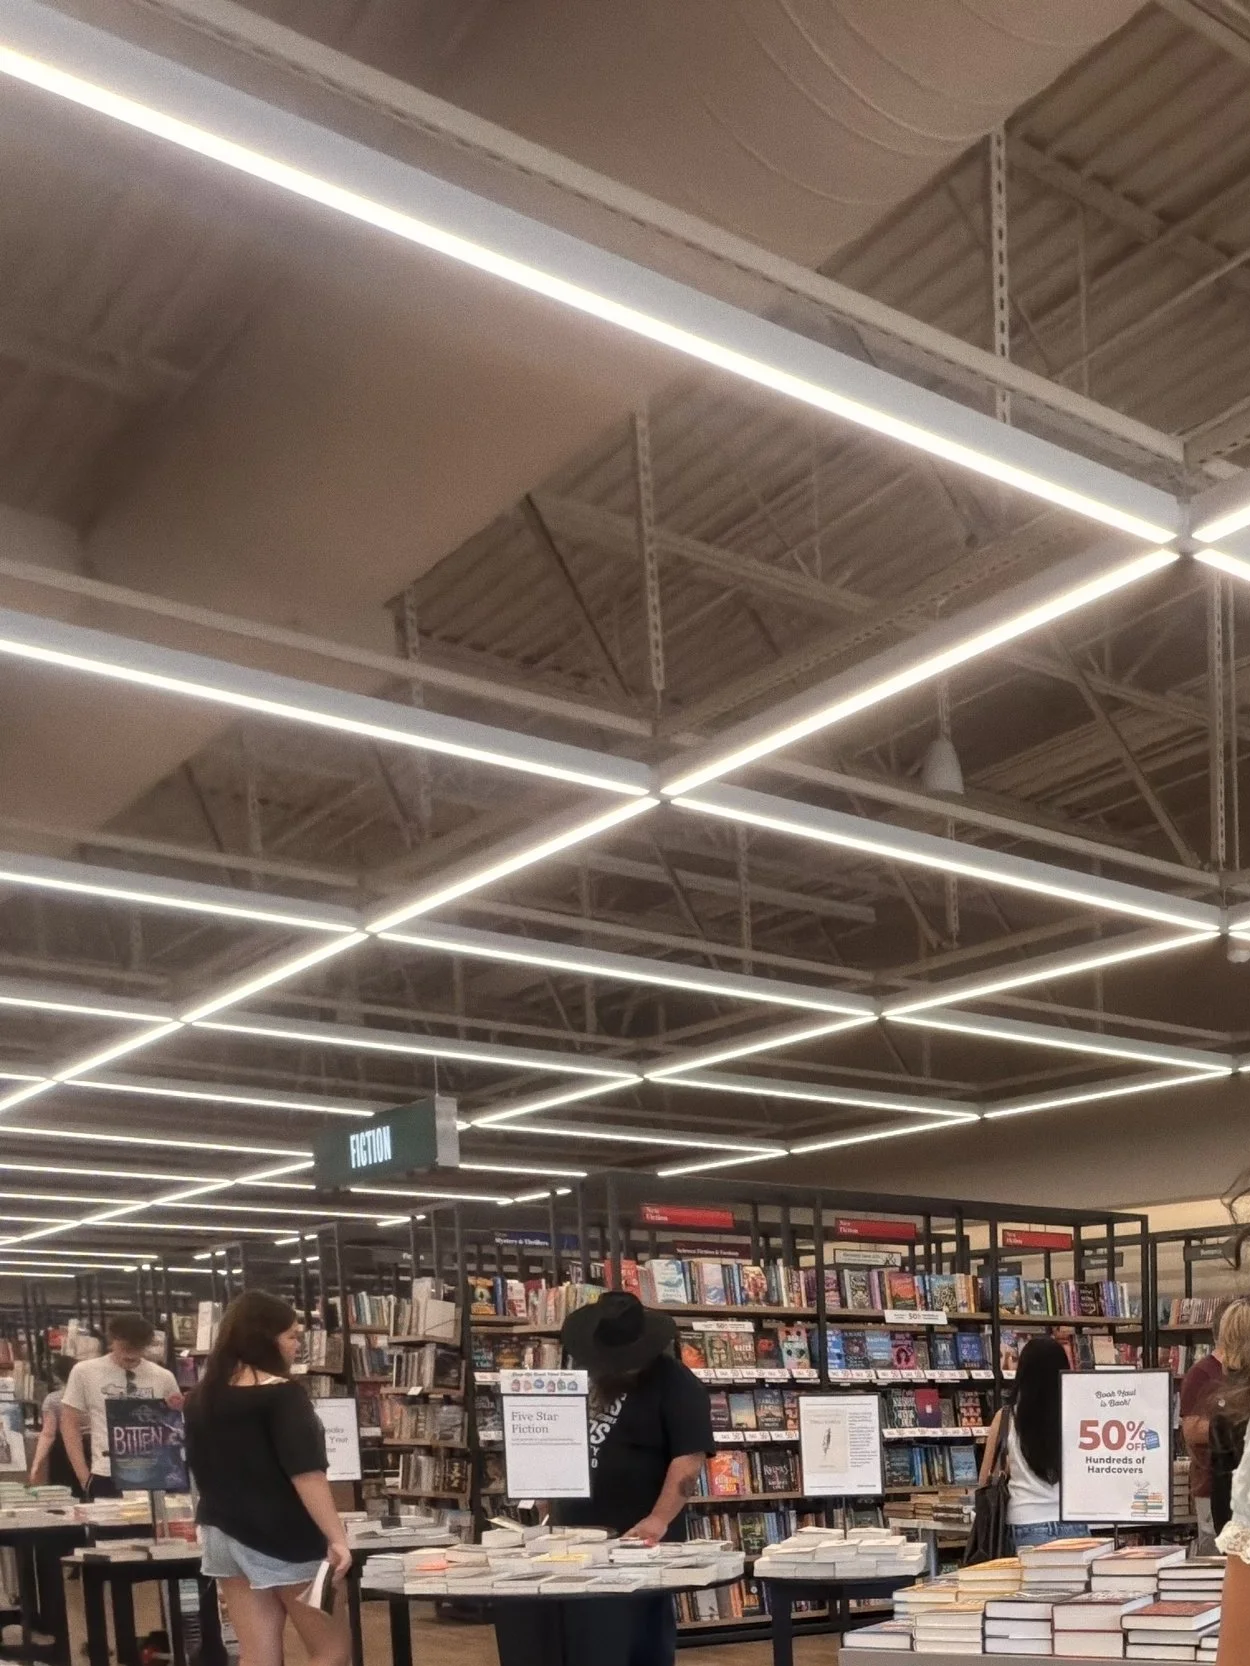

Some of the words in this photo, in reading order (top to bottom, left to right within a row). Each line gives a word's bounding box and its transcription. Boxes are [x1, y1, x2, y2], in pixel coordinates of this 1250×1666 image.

[351, 1126, 392, 1168] FICTION
[1095, 1389, 1116, 1399] Book
[1100, 1400, 1107, 1408] is
[1108, 1398, 1132, 1408] Back!
[511, 1411, 534, 1422] Five
[536, 1411, 559, 1422] Star
[511, 1424, 549, 1434] Fiction
[1078, 1419, 1148, 1451] 50%
[1126, 1442, 1147, 1451] OFF
[1085, 1456, 1133, 1465] Hundreds
[1136, 1456, 1146, 1465] of
[1087, 1465, 1143, 1474] Hardcovers
